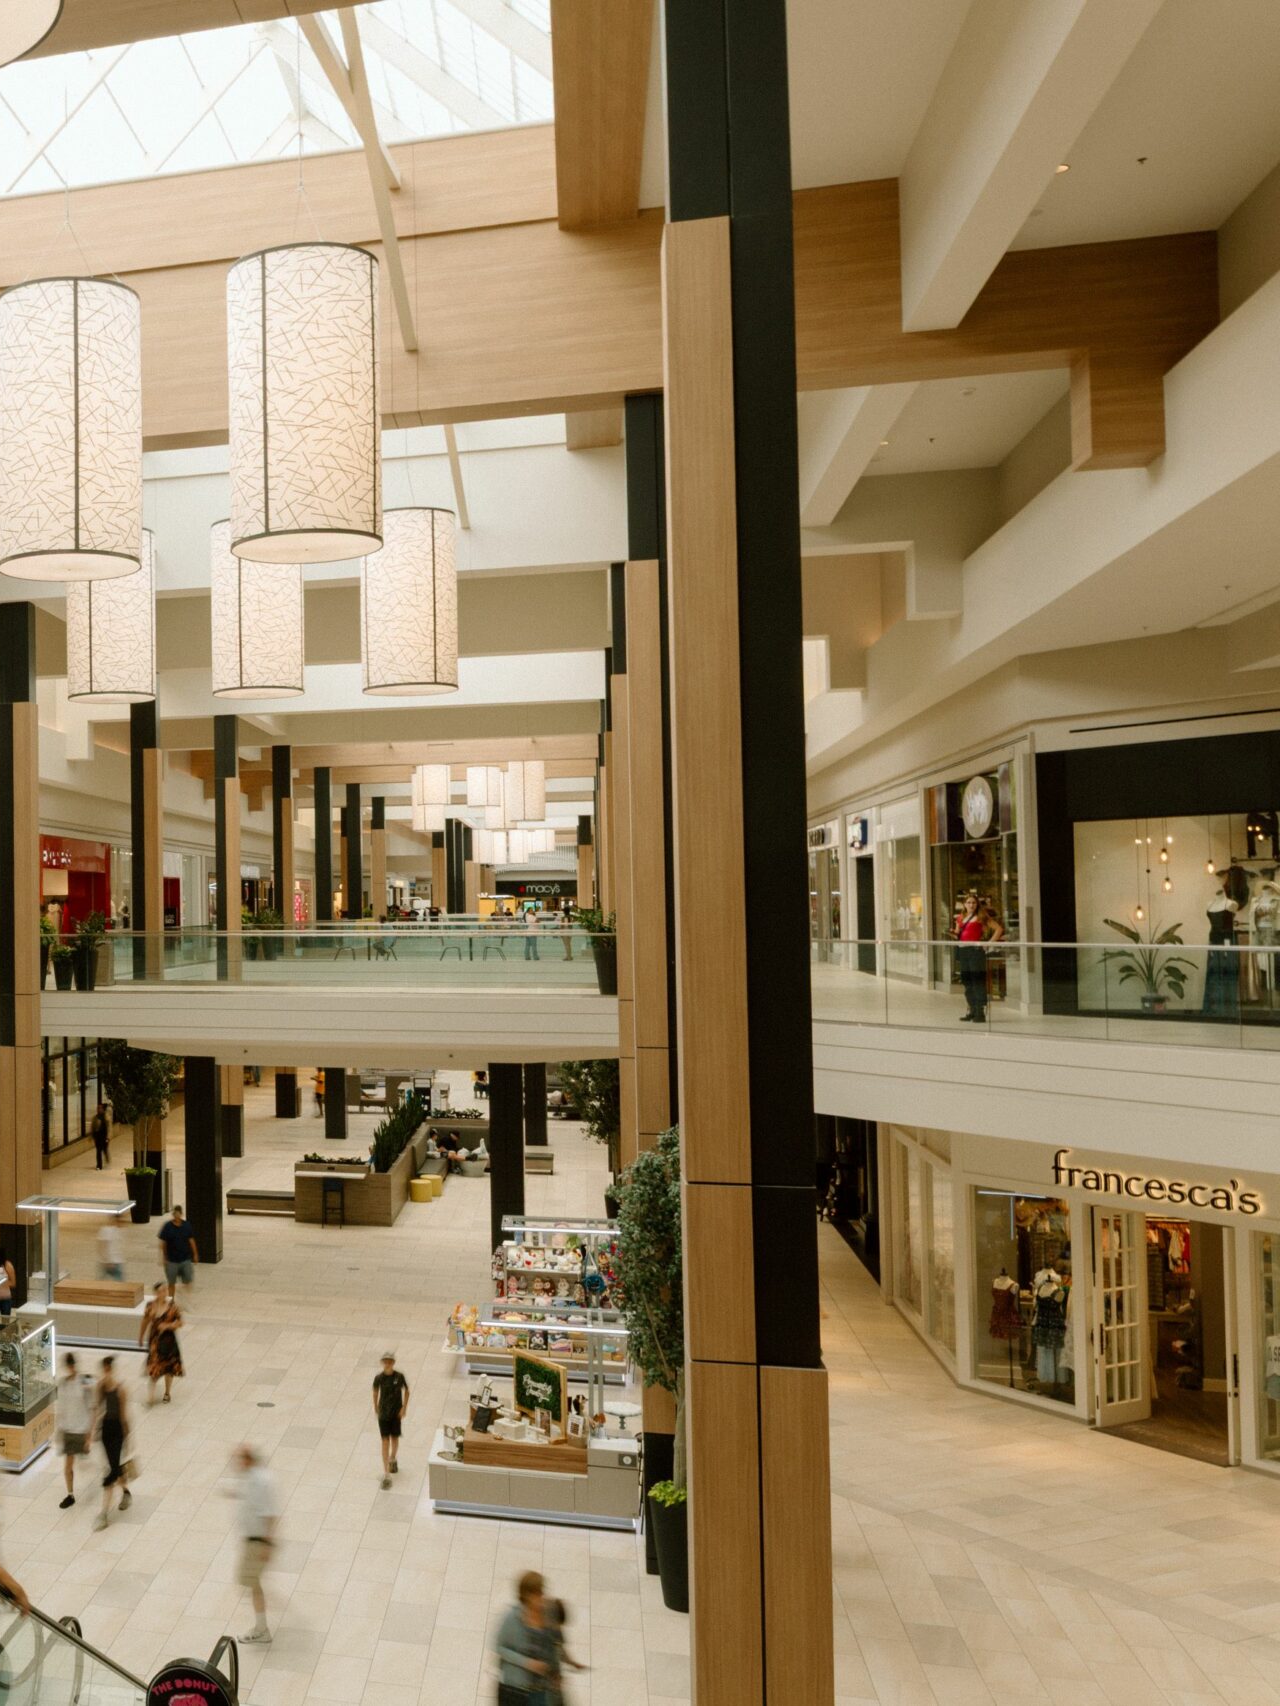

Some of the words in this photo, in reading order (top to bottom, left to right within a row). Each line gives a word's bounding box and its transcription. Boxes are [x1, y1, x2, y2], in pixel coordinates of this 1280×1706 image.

[526, 883, 561, 894] macy's
[1051, 1149, 1260, 1214] francesca's
[152, 1681, 173, 1696] THE
[175, 1678, 218, 1694] DONUT
